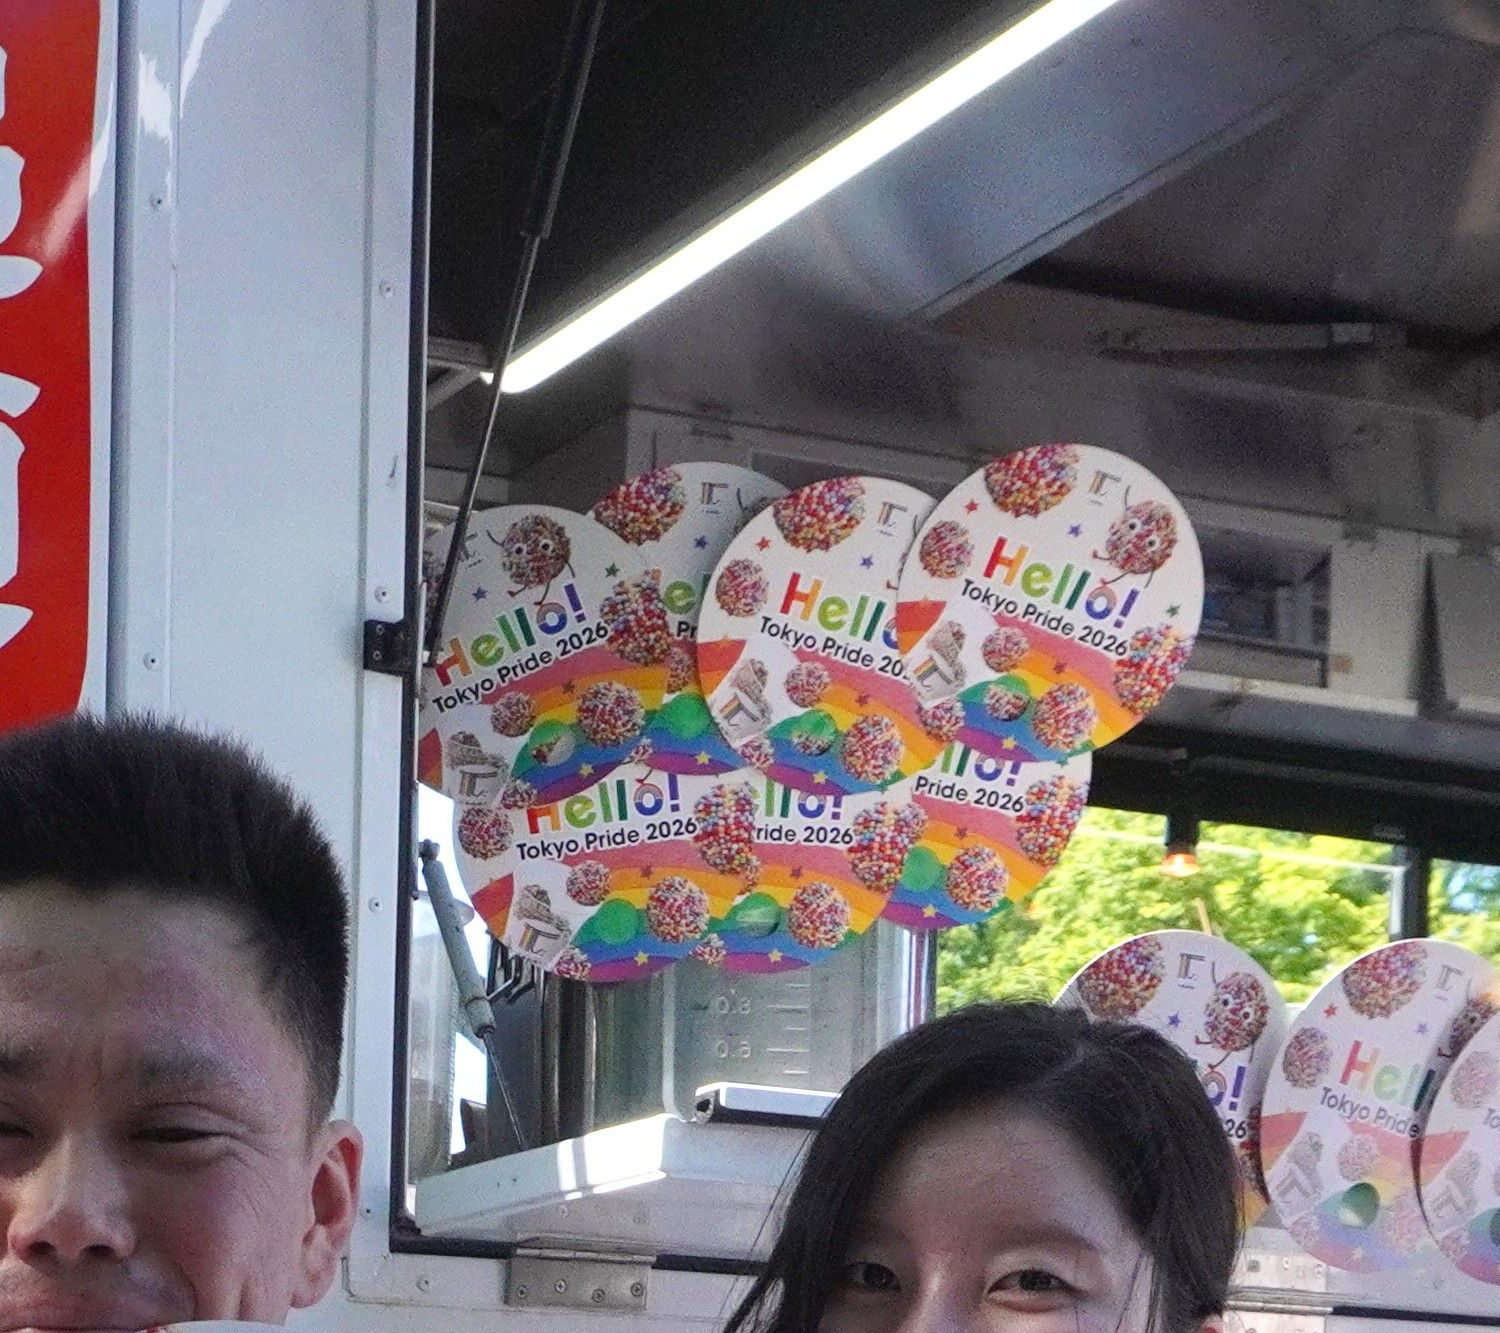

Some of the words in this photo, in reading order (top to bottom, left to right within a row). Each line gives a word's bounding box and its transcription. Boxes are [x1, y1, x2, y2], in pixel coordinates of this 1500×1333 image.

[983, 535, 1140, 629] Hello!
[434, 583, 586, 687] Hello!
[760, 615, 817, 654] Tokyo
[822, 636, 874, 668] Pride
[961, 578, 1018, 617] Tokyo
[1022, 602, 1075, 637] Pride
[1077, 623, 1129, 657] 2026
[432, 676, 495, 714] Tokyo
[497, 650, 552, 683] Pride
[556, 621, 609, 657] 2026
[526, 772, 681, 834] Hello!
[752, 777, 843, 820] llo!
[915, 775, 969, 801] Pride
[973, 788, 1025, 813] 2026
[515, 837, 579, 861] Tokyo
[585, 830, 640, 851] Pride
[645, 817, 698, 841] 2026
[803, 825, 853, 845] 2026
[1320, 1086, 1370, 1119] Tokyo
[1375, 1106, 1420, 1138] Pride
